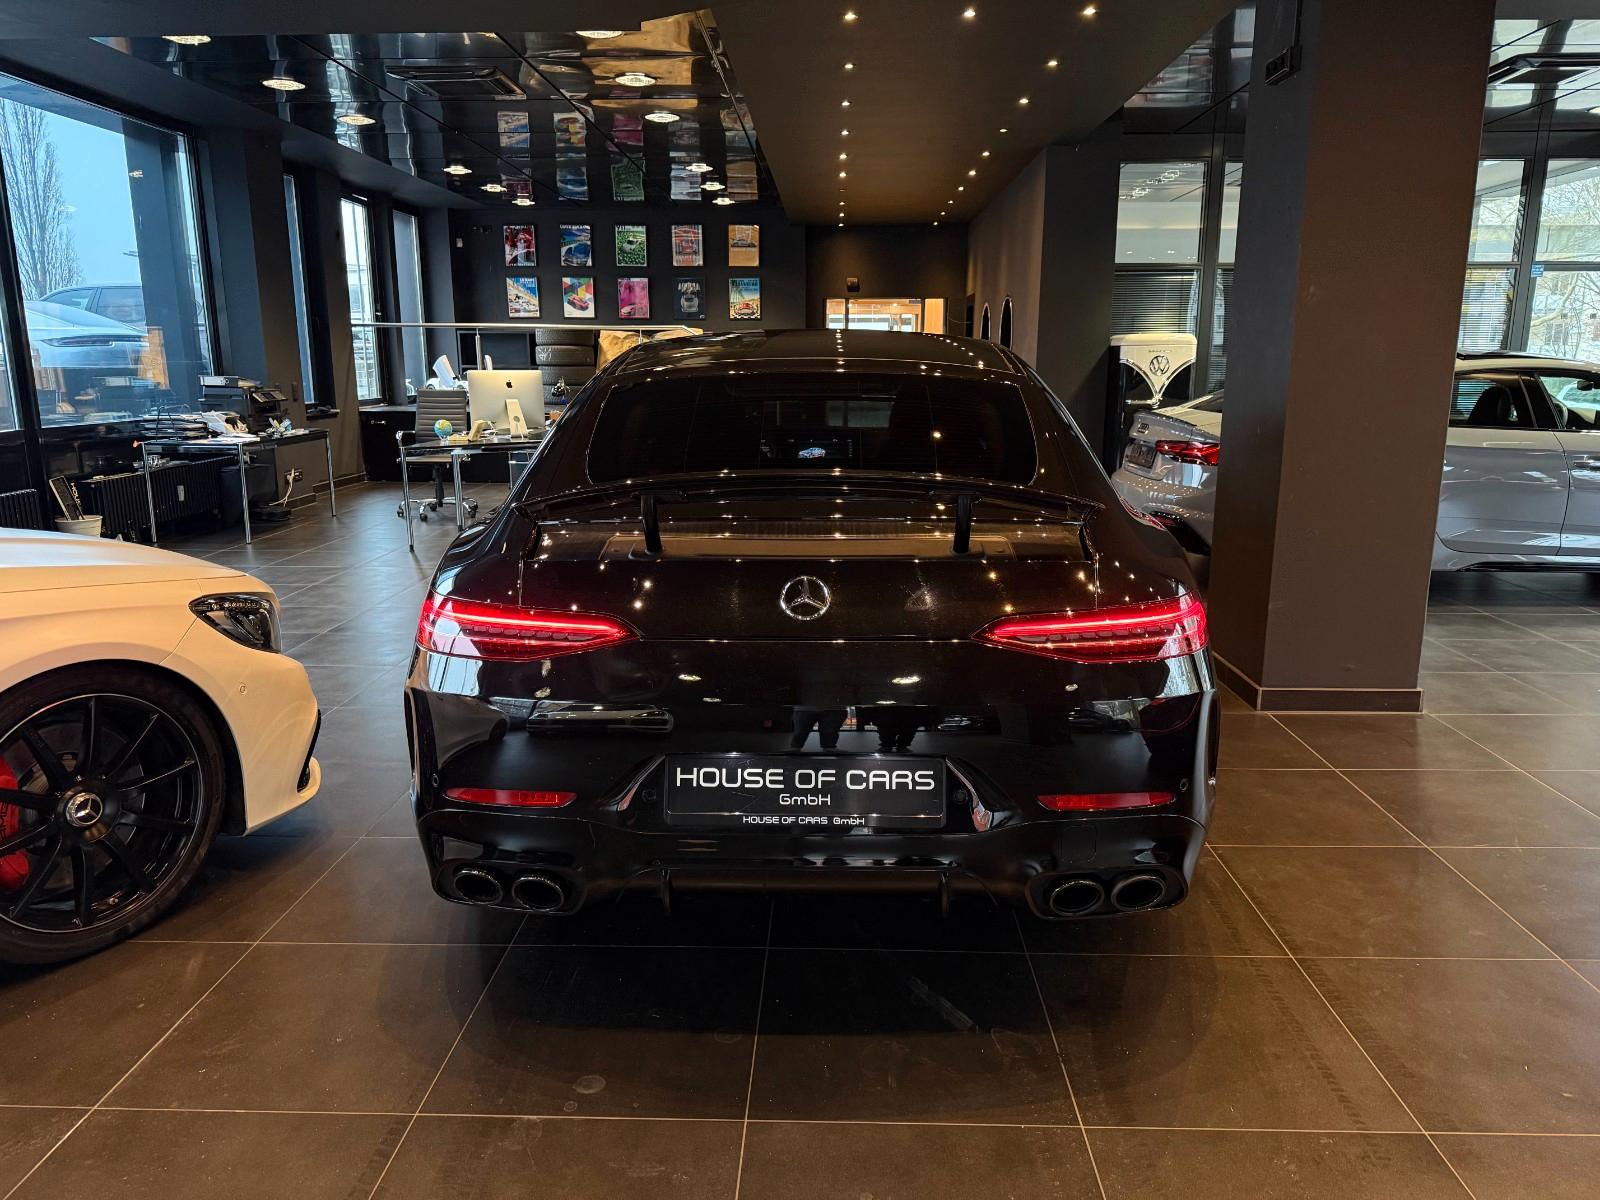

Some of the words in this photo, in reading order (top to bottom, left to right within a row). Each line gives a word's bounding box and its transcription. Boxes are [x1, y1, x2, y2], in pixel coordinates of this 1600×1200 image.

[676, 767, 785, 789] HOUSE
[795, 769, 836, 789] OF
[846, 769, 935, 790] CARS
[779, 793, 831, 806] GmbH
[742, 816, 780, 824] HOUSE
[781, 816, 796, 824] OF
[798, 816, 828, 825] CARS
[833, 817, 865, 826] GmbH
